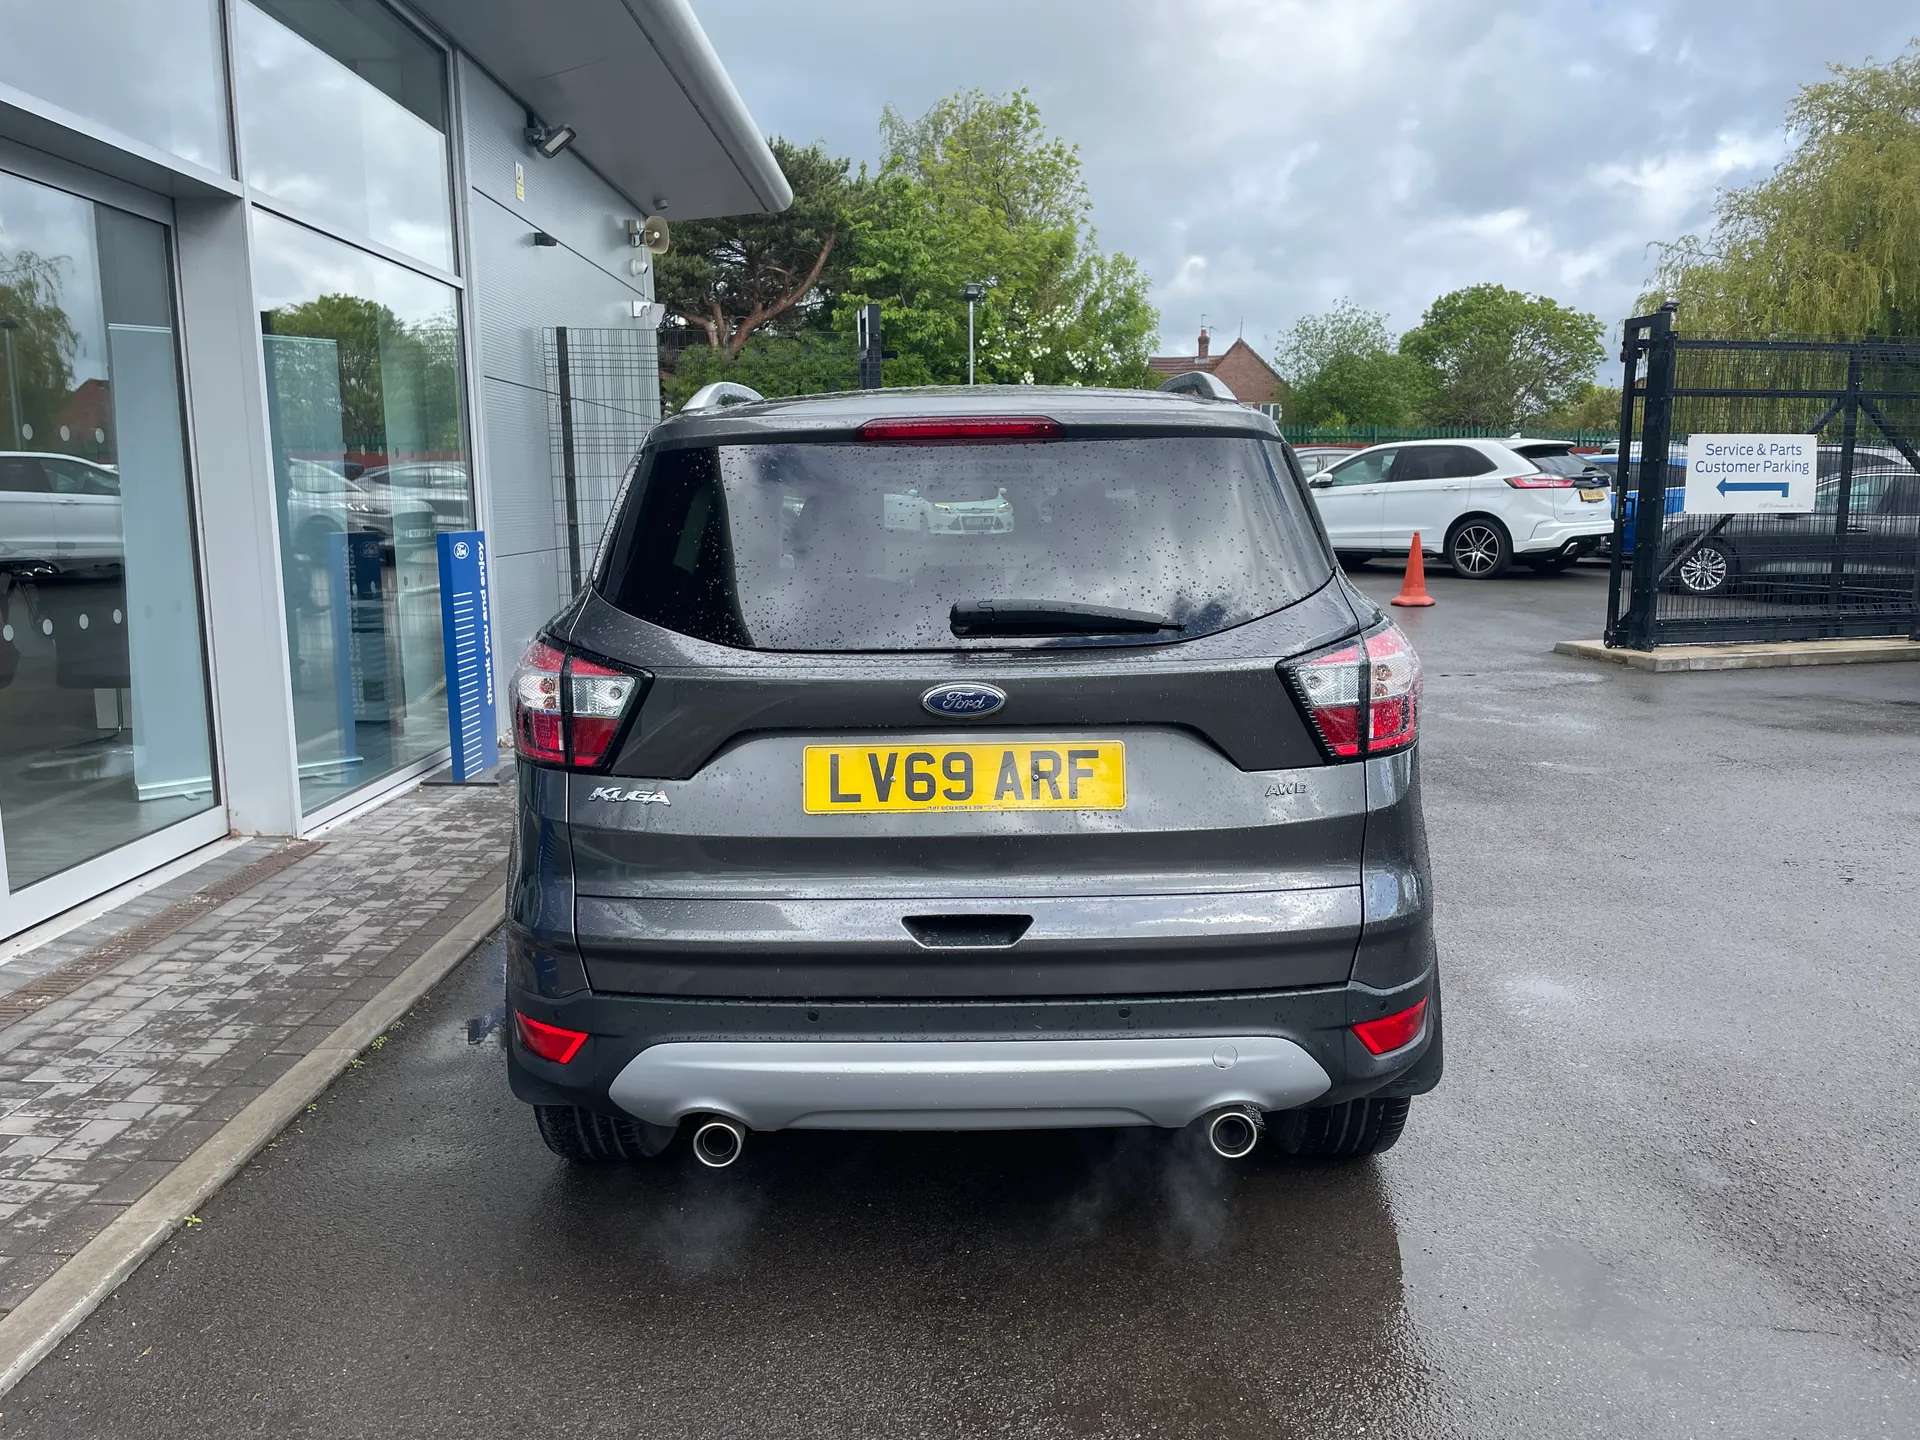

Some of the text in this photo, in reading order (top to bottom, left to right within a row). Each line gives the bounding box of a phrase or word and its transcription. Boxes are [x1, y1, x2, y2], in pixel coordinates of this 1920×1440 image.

[1705, 443, 1802, 456] Service & Parts
[1695, 460, 1809, 475] Customer Parking
[477, 541, 493, 706] thank you and enjoy
[942, 690, 985, 711] Ford
[829, 749, 1099, 803] LV69 ARF
[588, 786, 671, 807] KUGA
